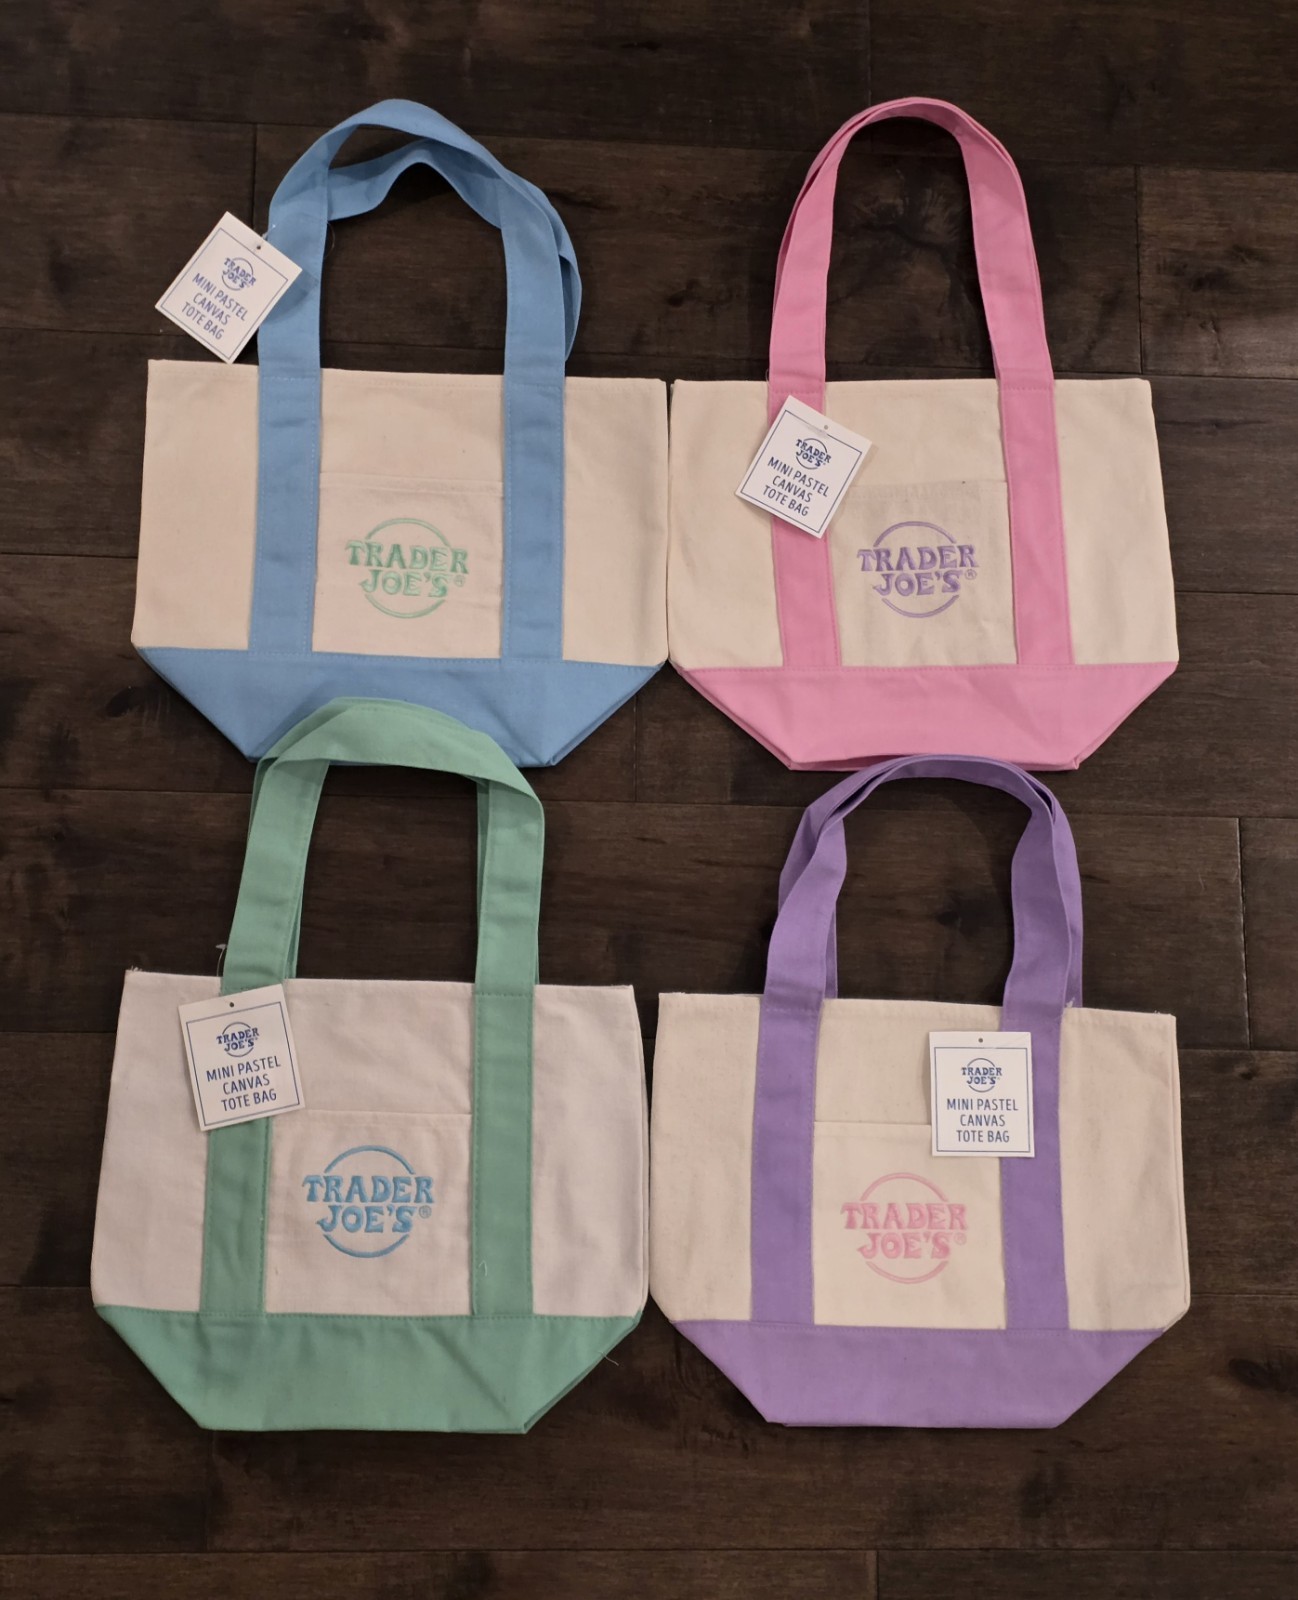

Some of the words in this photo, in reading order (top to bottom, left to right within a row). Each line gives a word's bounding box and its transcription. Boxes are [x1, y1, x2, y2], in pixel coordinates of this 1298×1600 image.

[224, 258, 256, 287] TRADER
[193, 273, 216, 295] MINI
[215, 290, 249, 321] PASTEL
[193, 293, 230, 325] CANVAS
[182, 302, 204, 324] TOTE
[204, 322, 224, 340] BAG
[796, 439, 831, 463] TRADER
[768, 457, 793, 477] MINI
[793, 471, 829, 497] PASTEL
[773, 475, 812, 503] CANVAS
[763, 485, 788, 505] TOTE
[788, 500, 809, 516] BAG
[345, 540, 469, 574] TRADER
[857, 545, 979, 571] TRADER
[216, 1028, 259, 1044] TRADER
[206, 1065, 234, 1081] MINI
[238, 1056, 281, 1075] PASTEL
[961, 1067, 1002, 1076] TRADER
[223, 1074, 270, 1095] CANVAS
[222, 1094, 250, 1111] TOTE
[253, 1089, 276, 1104] BAG
[947, 1098, 973, 1110] MINI
[977, 1099, 1019, 1111] PASTEL
[960, 1114, 1005, 1126] CANVAS
[956, 1130, 983, 1142] TOTE
[988, 1131, 1010, 1143] BAG
[302, 1175, 434, 1203] TRADER
[840, 1202, 968, 1230] TRADER
